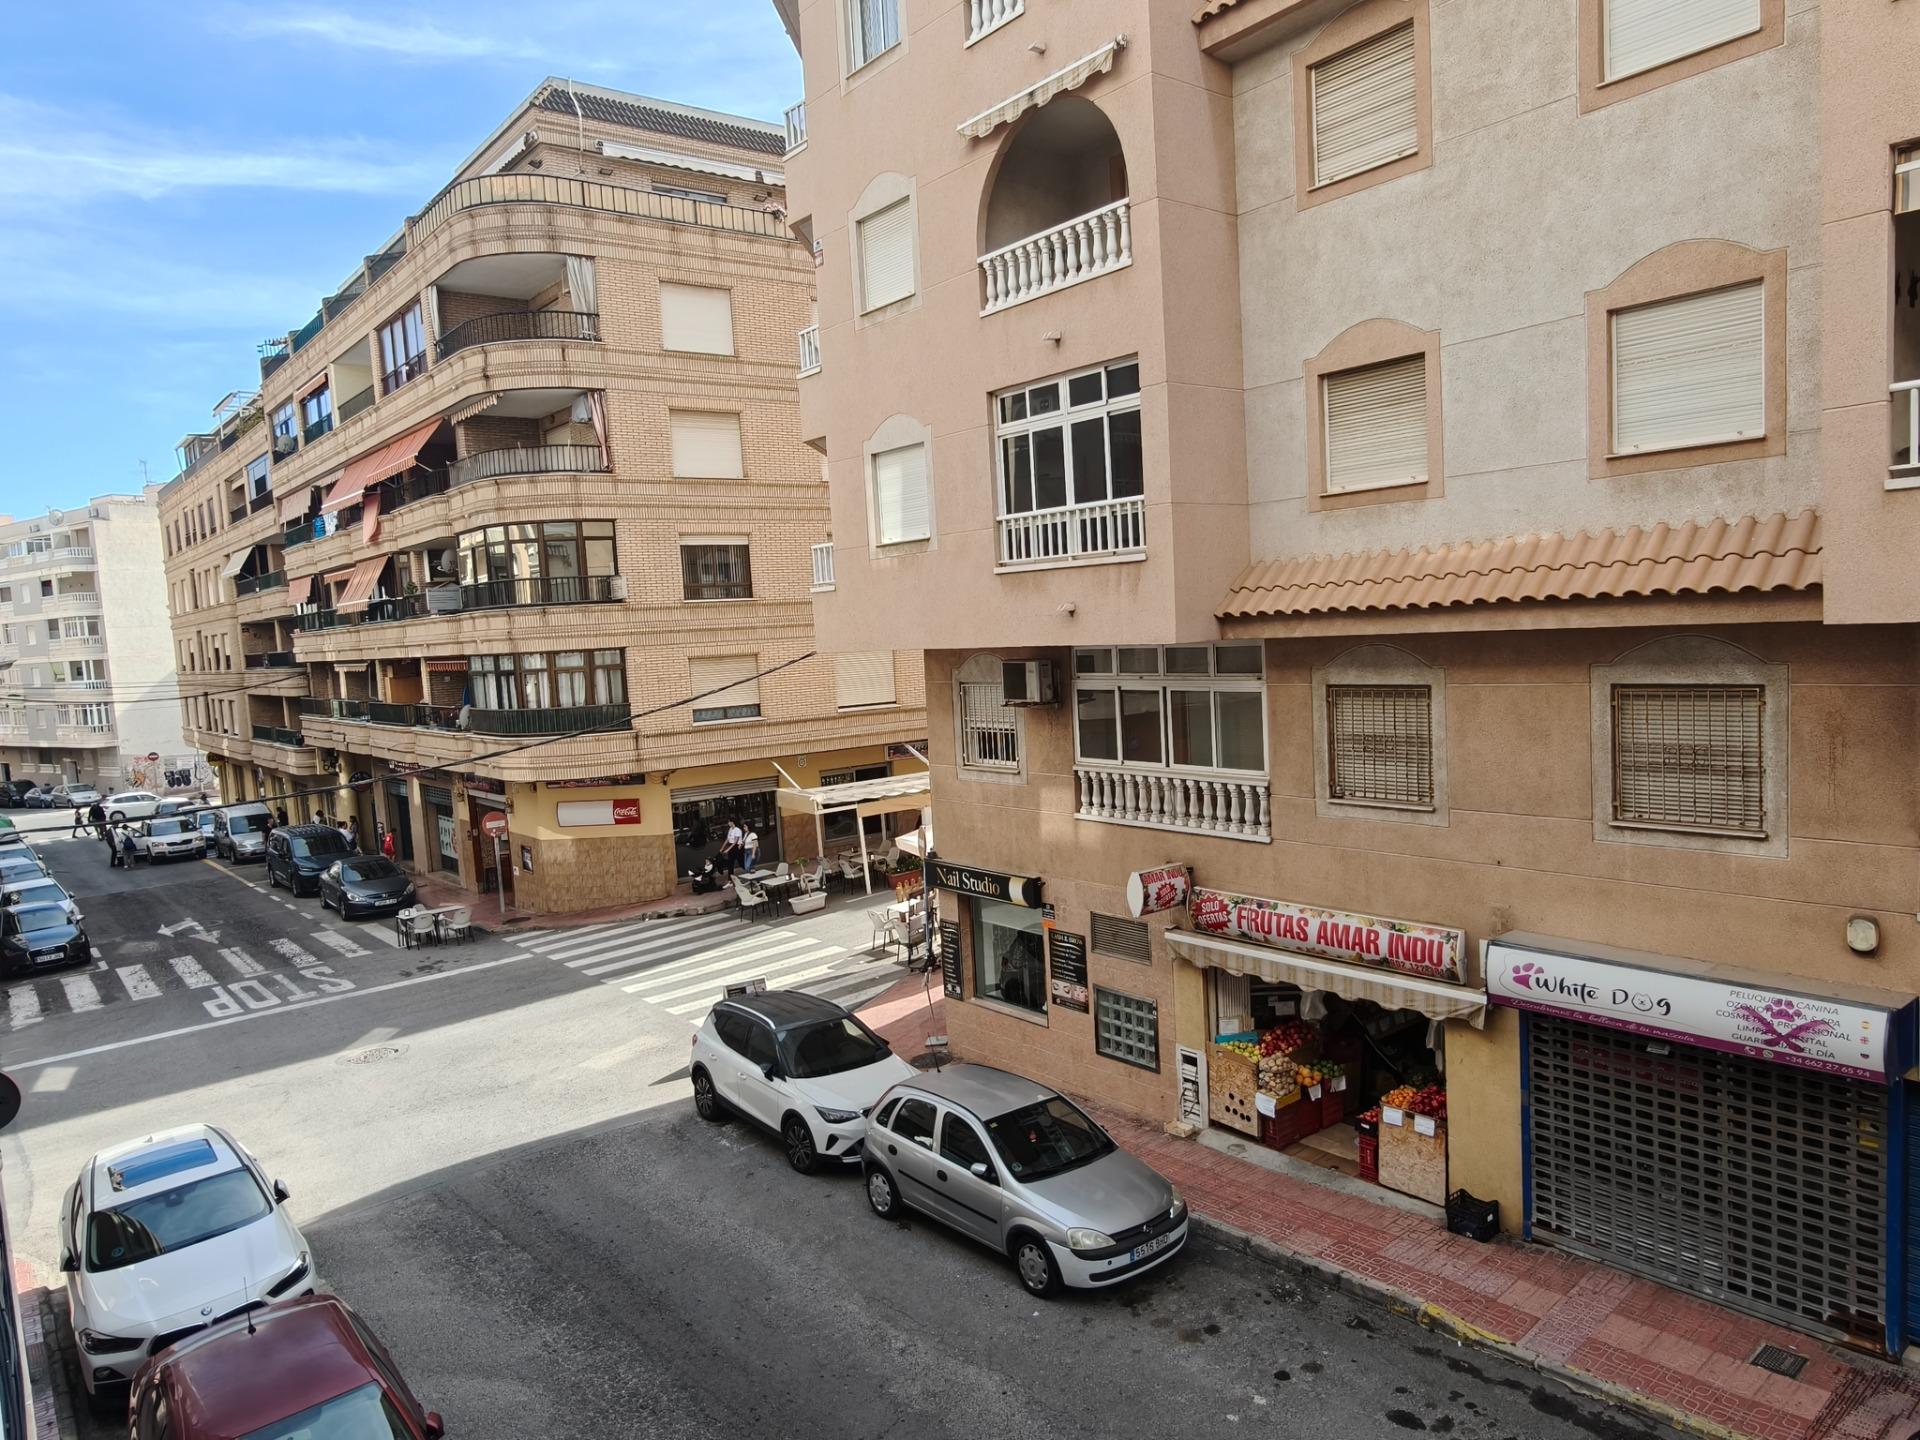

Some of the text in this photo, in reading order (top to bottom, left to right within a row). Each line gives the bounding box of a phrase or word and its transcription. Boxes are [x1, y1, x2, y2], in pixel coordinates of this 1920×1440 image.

[614, 806, 639, 819] Coca-Cola
[936, 866, 1000, 895] Nail Studio
[1142, 868, 1184, 885] AMAR INDU
[1201, 900, 1220, 913] SOLO
[1198, 911, 1228, 924] OFERTAS
[1236, 906, 1445, 968] FRUTAS AMAR INDU
[202, 966, 356, 1018] STOP
[1535, 976, 1600, 1004] White
[1796, 1001, 1839, 1016] CANINA
[1777, 1021, 1852, 1042] PROSIONAL
[1816, 1049, 1836, 1060] DÍA
[1804, 1058, 1823, 1069] 662
[1825, 1063, 1839, 1071] 27
[1841, 1066, 1854, 1075] 65
